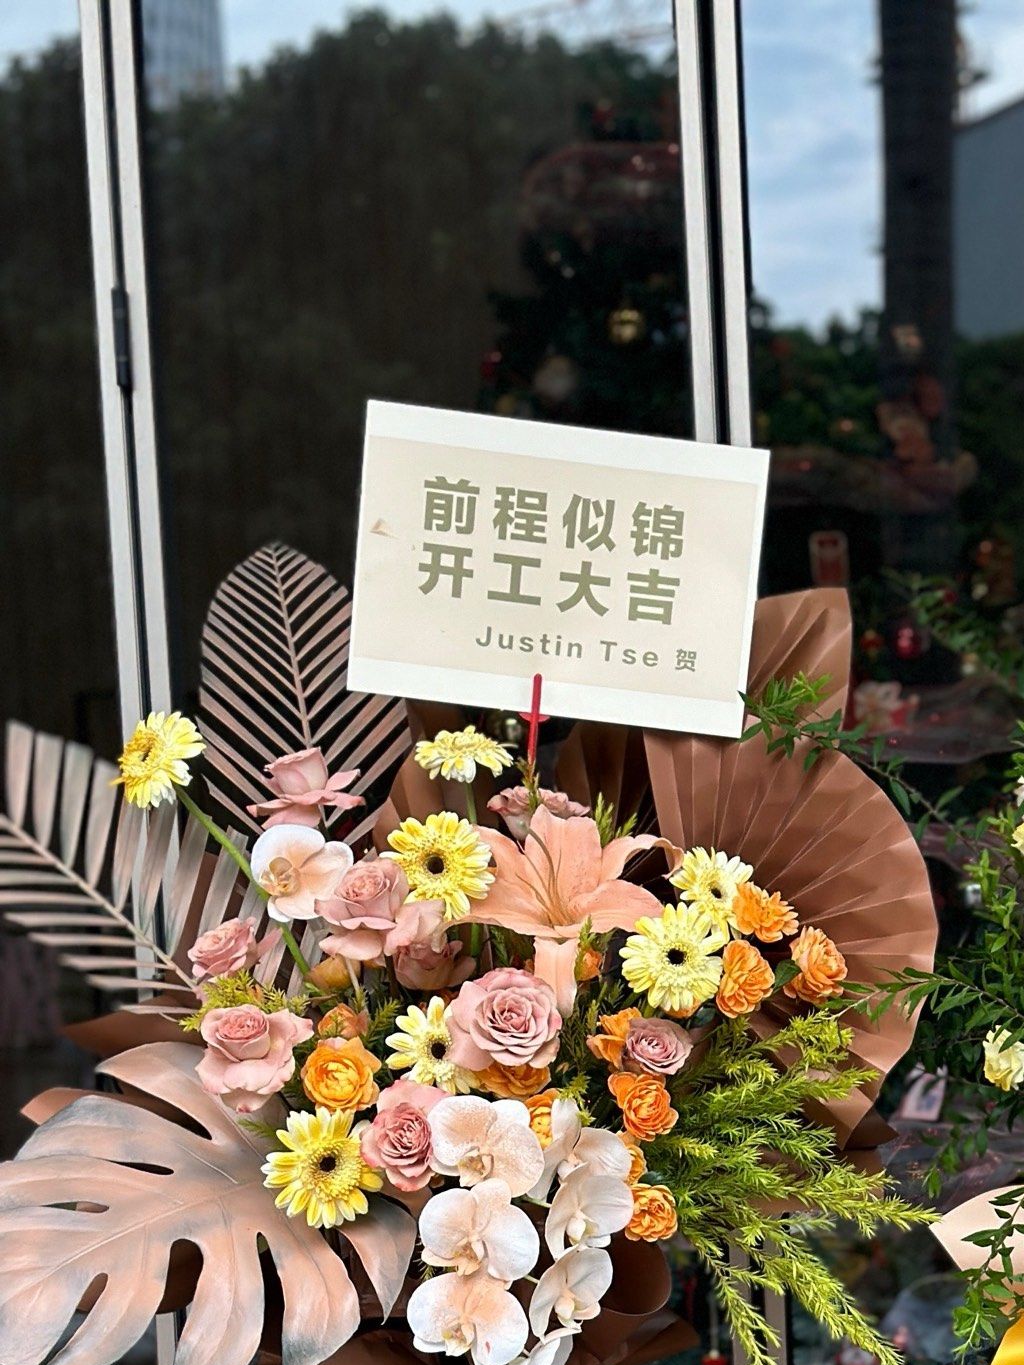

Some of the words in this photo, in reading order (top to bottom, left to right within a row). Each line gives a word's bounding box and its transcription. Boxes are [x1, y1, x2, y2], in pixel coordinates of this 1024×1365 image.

[423, 475, 685, 561] 前程似锦
[418, 542, 681, 626] 开工大吉
[475, 626, 583, 659] Justin
[600, 640, 660, 667] Tse
[674, 647, 698, 672] 贺
